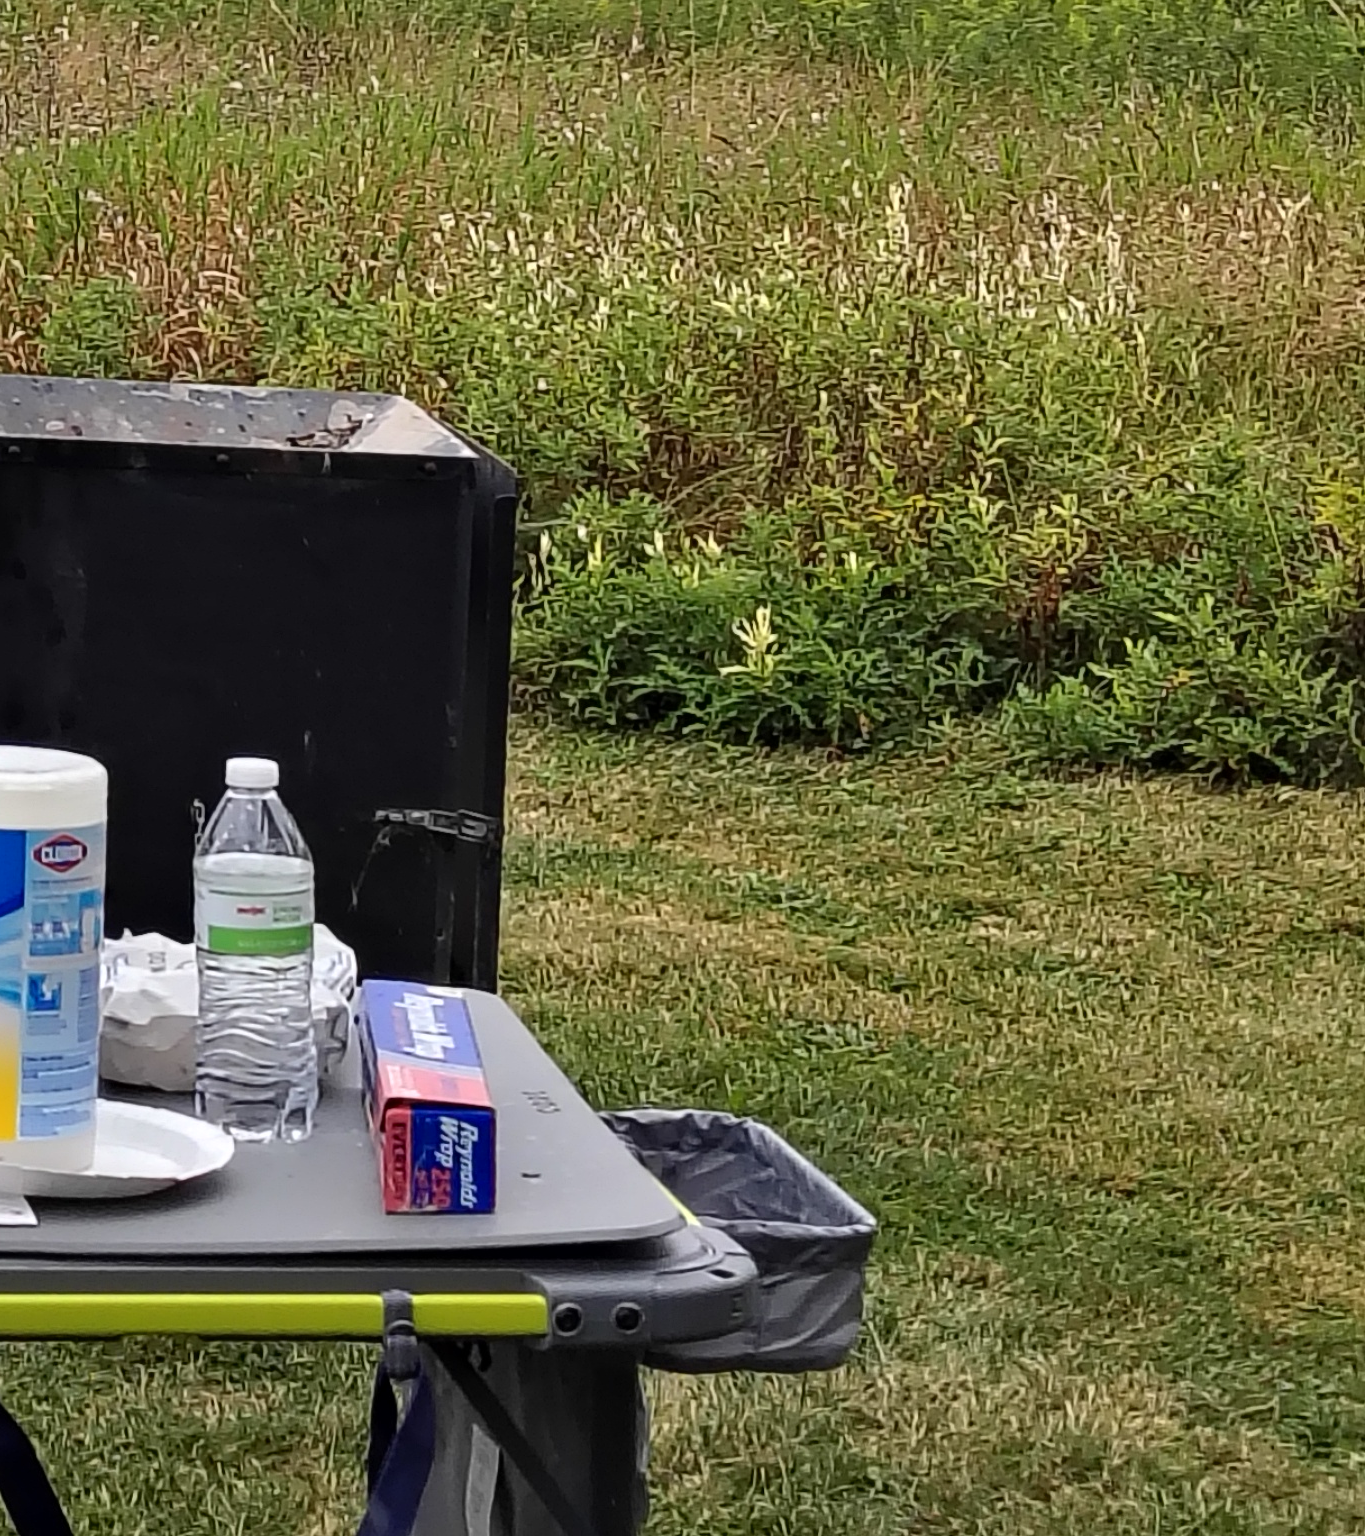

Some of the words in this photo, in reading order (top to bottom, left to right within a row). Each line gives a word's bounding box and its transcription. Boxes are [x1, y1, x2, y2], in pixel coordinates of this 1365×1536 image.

[433, 1115, 454, 1169] Wrap
[454, 1120, 479, 1209] Reynolds
[430, 1166, 452, 1208] 250
